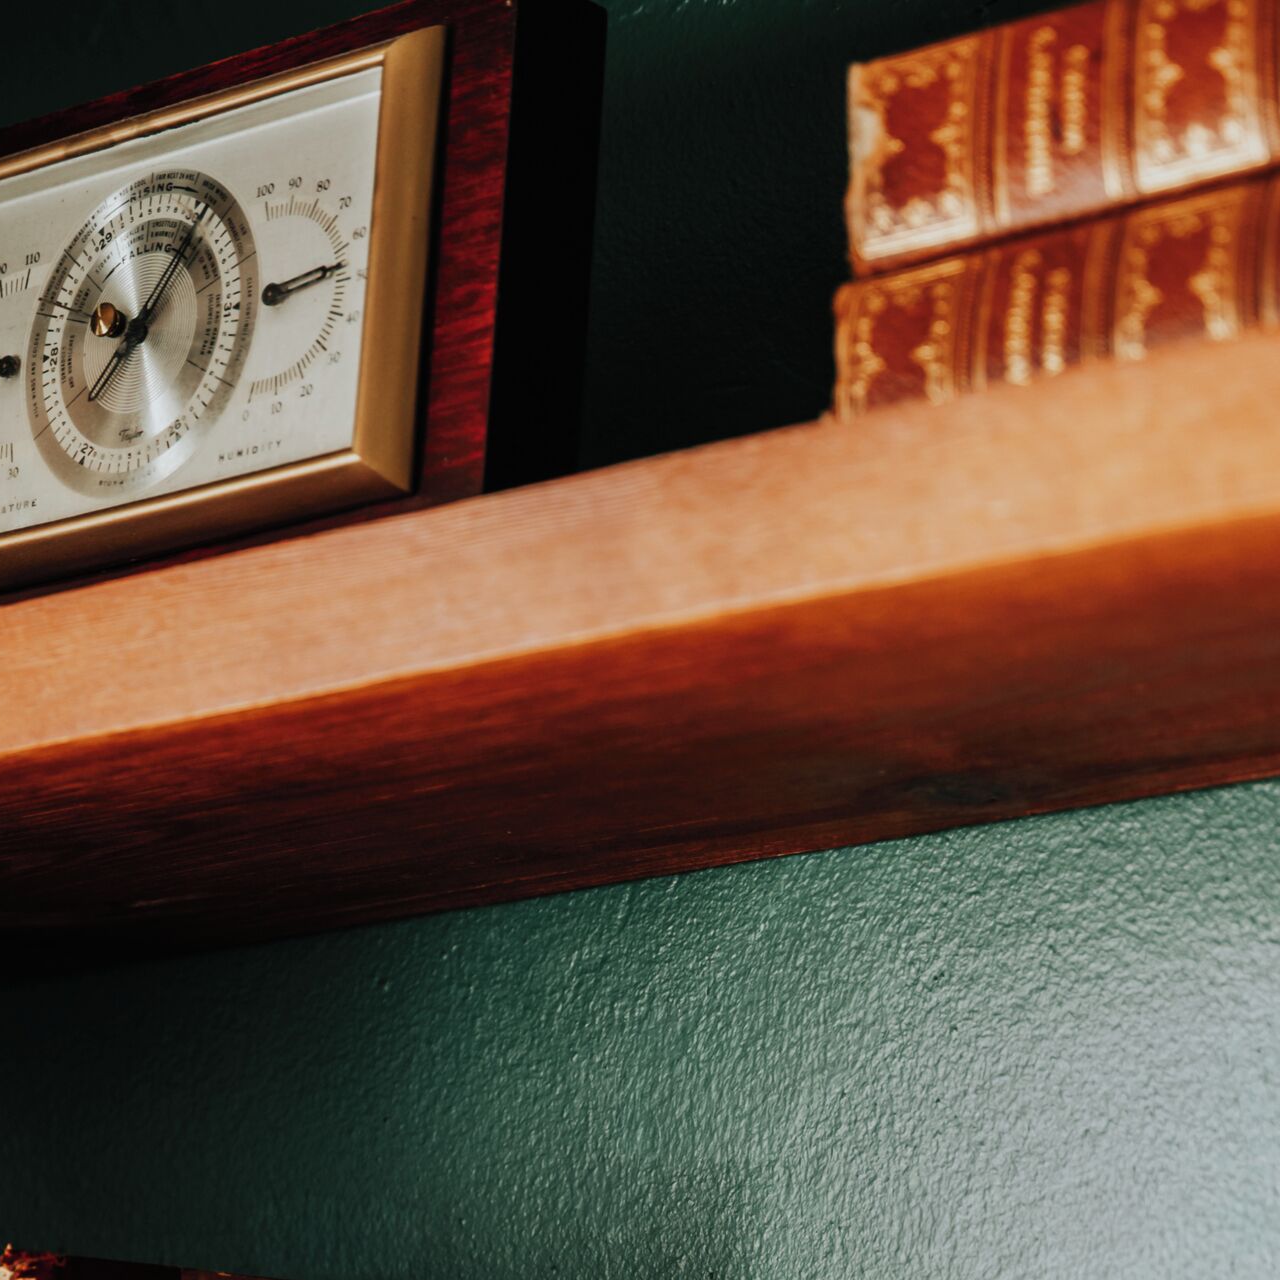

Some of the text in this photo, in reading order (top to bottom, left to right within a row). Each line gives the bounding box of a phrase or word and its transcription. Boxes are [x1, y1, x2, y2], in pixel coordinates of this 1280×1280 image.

[256, 183, 275, 198] 100
[289, 176, 303, 190] 90
[317, 178, 331, 192] 80
[130, 183, 174, 203] RISING
[339, 196, 352, 210] 70
[352, 226, 368, 241] 60
[99, 232, 113, 251] 29
[24, 252, 41, 267] 110
[121, 243, 173, 263] FALLING
[223, 302, 232, 318] 31
[346, 311, 360, 325] 40
[49, 347, 59, 367] 28
[327, 351, 342, 366] 30
[299, 384, 314, 399] 20
[271, 401, 283, 416] 10
[168, 419, 182, 437] 26
[80, 443, 94, 457] 27
[218, 438, 283, 462] HUMIDITY
[7, 466, 20, 480] 30
